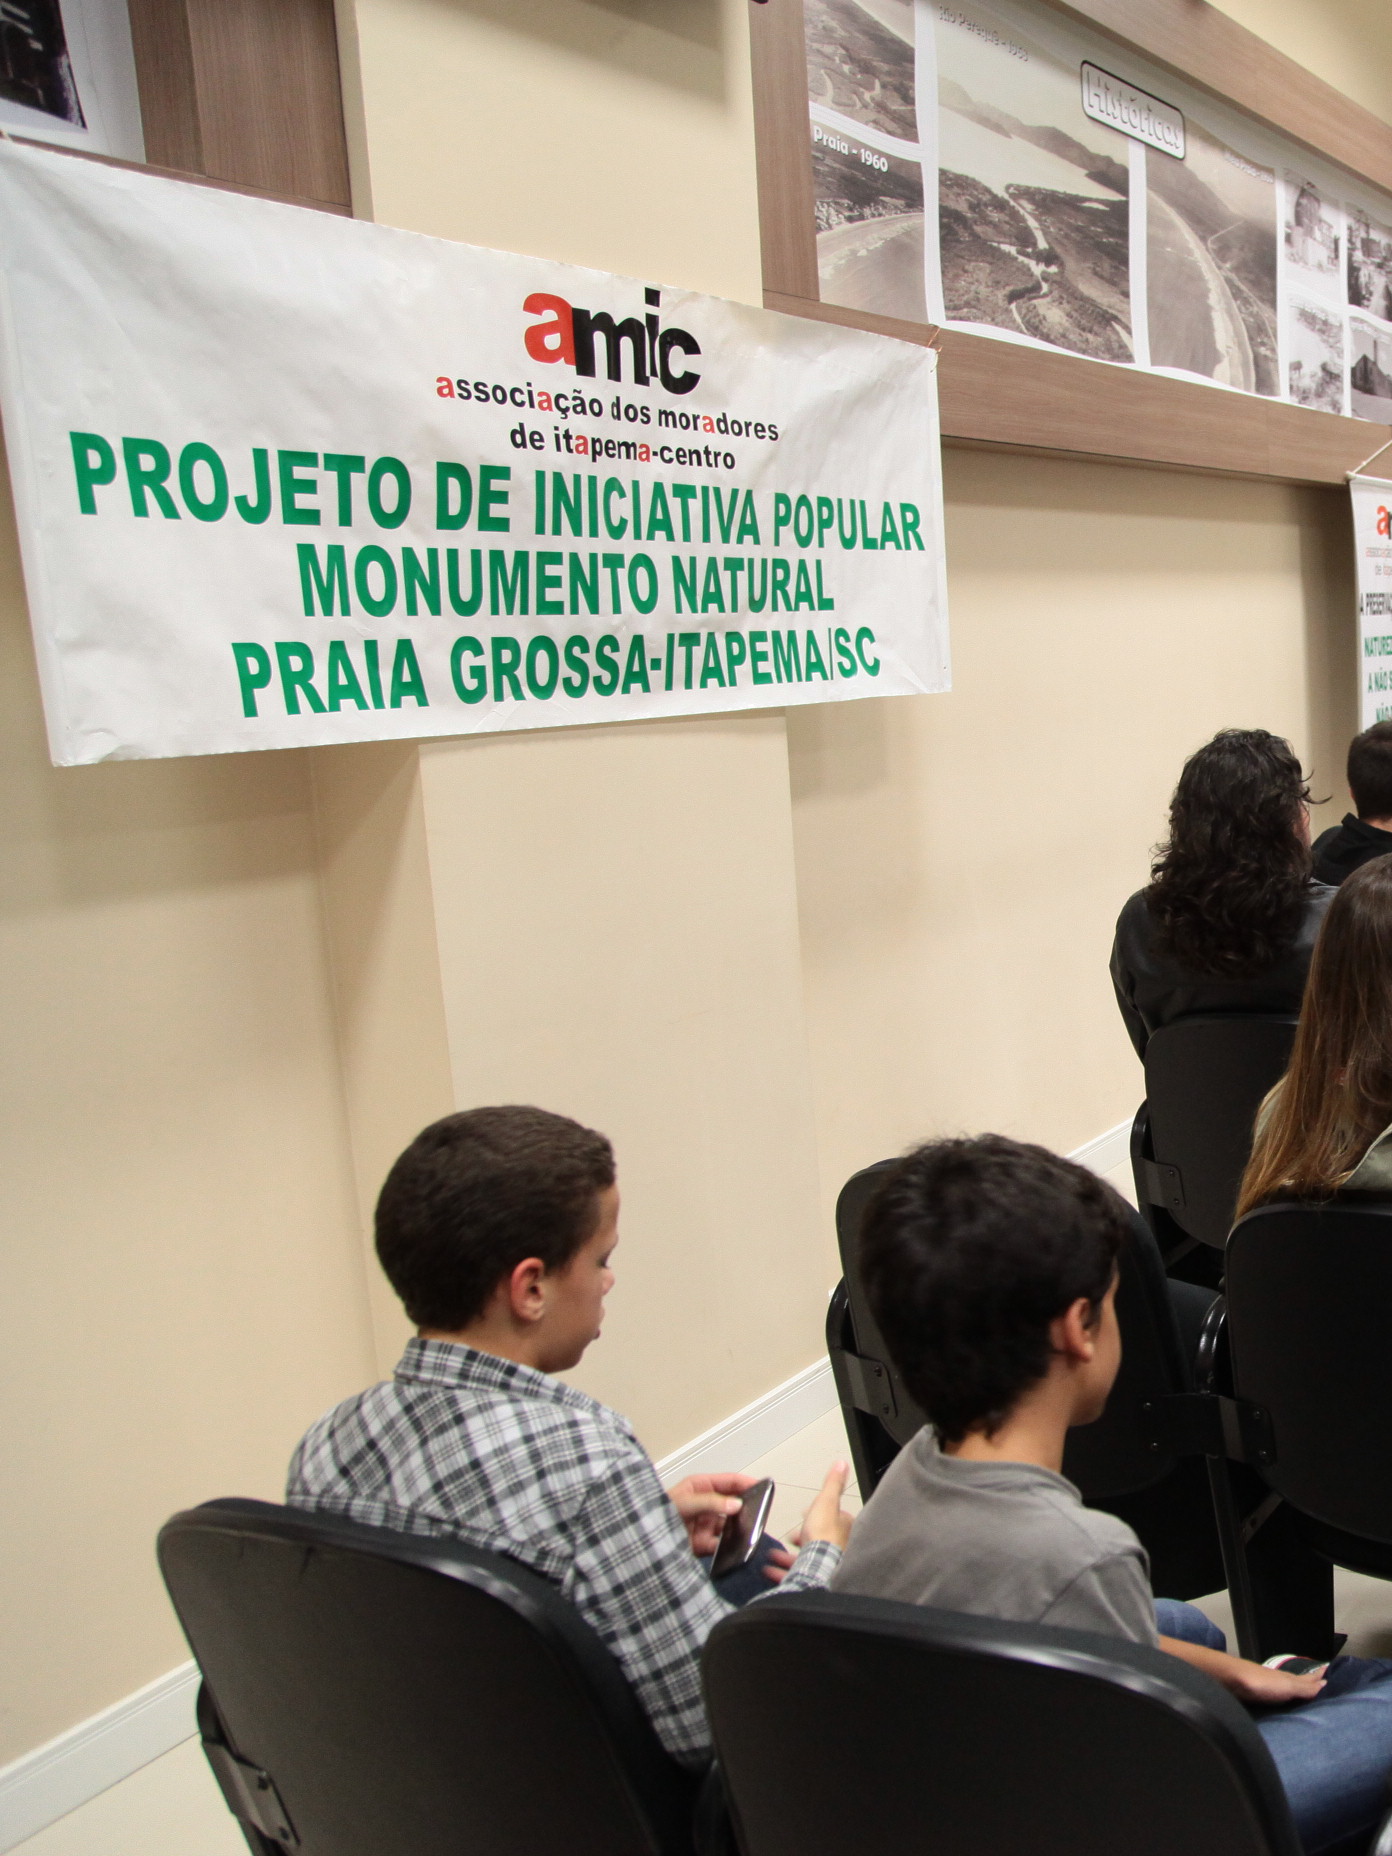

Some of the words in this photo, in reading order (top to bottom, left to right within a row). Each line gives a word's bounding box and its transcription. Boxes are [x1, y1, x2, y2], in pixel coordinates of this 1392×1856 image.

[813, 125, 849, 156] Praia
[860, 148, 889, 173] 1960
[522, 286, 701, 395] amic
[436, 376, 603, 419] associação
[611, 396, 651, 425] dos
[658, 407, 779, 442] moradores
[510, 422, 545, 451] de
[554, 426, 736, 470] itapema-centro
[69, 431, 412, 529] PROJETO
[435, 461, 511, 533] DE
[534, 469, 761, 546] INICIATIVA
[773, 491, 926, 551] POPULAR
[296, 543, 659, 617] MONUMENTO
[672, 555, 835, 614] NATURAL
[231, 638, 430, 718] PRAIA
[450, 626, 881, 702] GROSSA-ITAPEMA/SC
